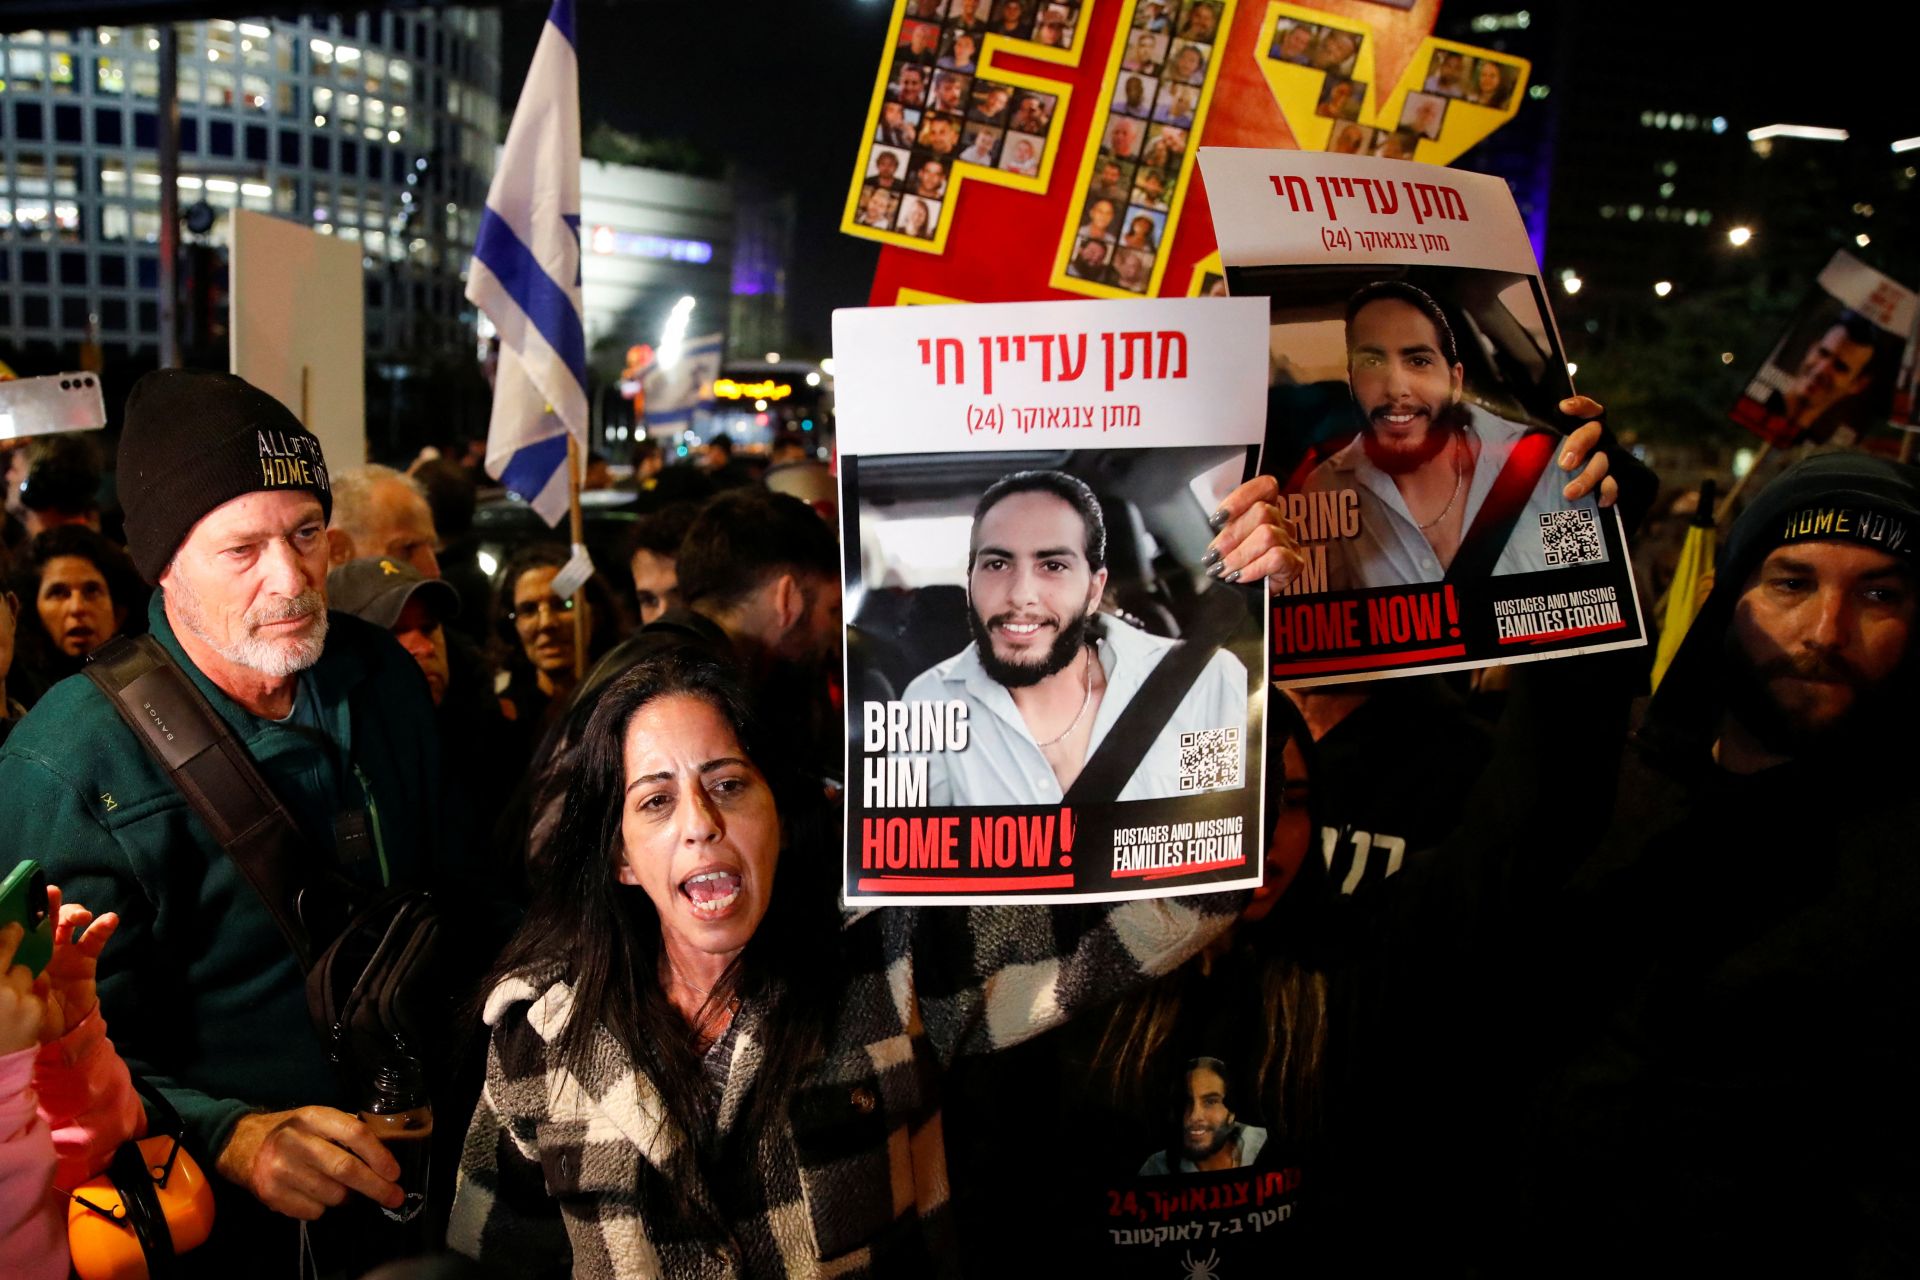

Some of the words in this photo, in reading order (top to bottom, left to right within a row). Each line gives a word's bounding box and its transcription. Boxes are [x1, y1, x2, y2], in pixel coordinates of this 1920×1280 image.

[1269, 175, 1314, 213] חי
[1316, 176, 1398, 221] עדיין
[1402, 181, 1469, 225] מתן
[1321, 226, 1352, 251] (24)
[1355, 231, 1418, 252] צנגאוקר
[1419, 233, 1450, 254] מתן
[918, 338, 964, 385] חי
[979, 333, 1087, 395] עדיין
[1102, 331, 1187, 392] מתן
[967, 404, 1004, 435] (24)
[1012, 406, 1093, 433] צנגאוקר
[1102, 404, 1141, 430] מתן
[257, 430, 295, 457] ALL
[260, 457, 314, 487] HOME
[1784, 508, 1850, 539] HOME
[1856, 510, 1908, 550] NOW
[1274, 599, 1361, 655] HOME
[1368, 584, 1461, 645] NOW!
[1494, 596, 1546, 617] HOSTAGES
[1547, 593, 1568, 610] AND
[1568, 586, 1617, 607] MISSING
[1497, 610, 1564, 639] FAMILIES
[1565, 601, 1621, 630] FORUM
[863, 699, 968, 752] BRING
[863, 757, 928, 808] HIM
[862, 816, 960, 869] HOME
[970, 807, 1077, 868] NOW!
[1114, 825, 1169, 846] HOSTAGES
[1170, 822, 1193, 841] AND
[1195, 816, 1243, 838] MISSING
[1113, 841, 1183, 871] FAMILIES
[1186, 834, 1243, 865] FORUM
[1108, 1220, 1204, 1248] לאוקטובר
[1247, 1201, 1297, 1233] חטף
